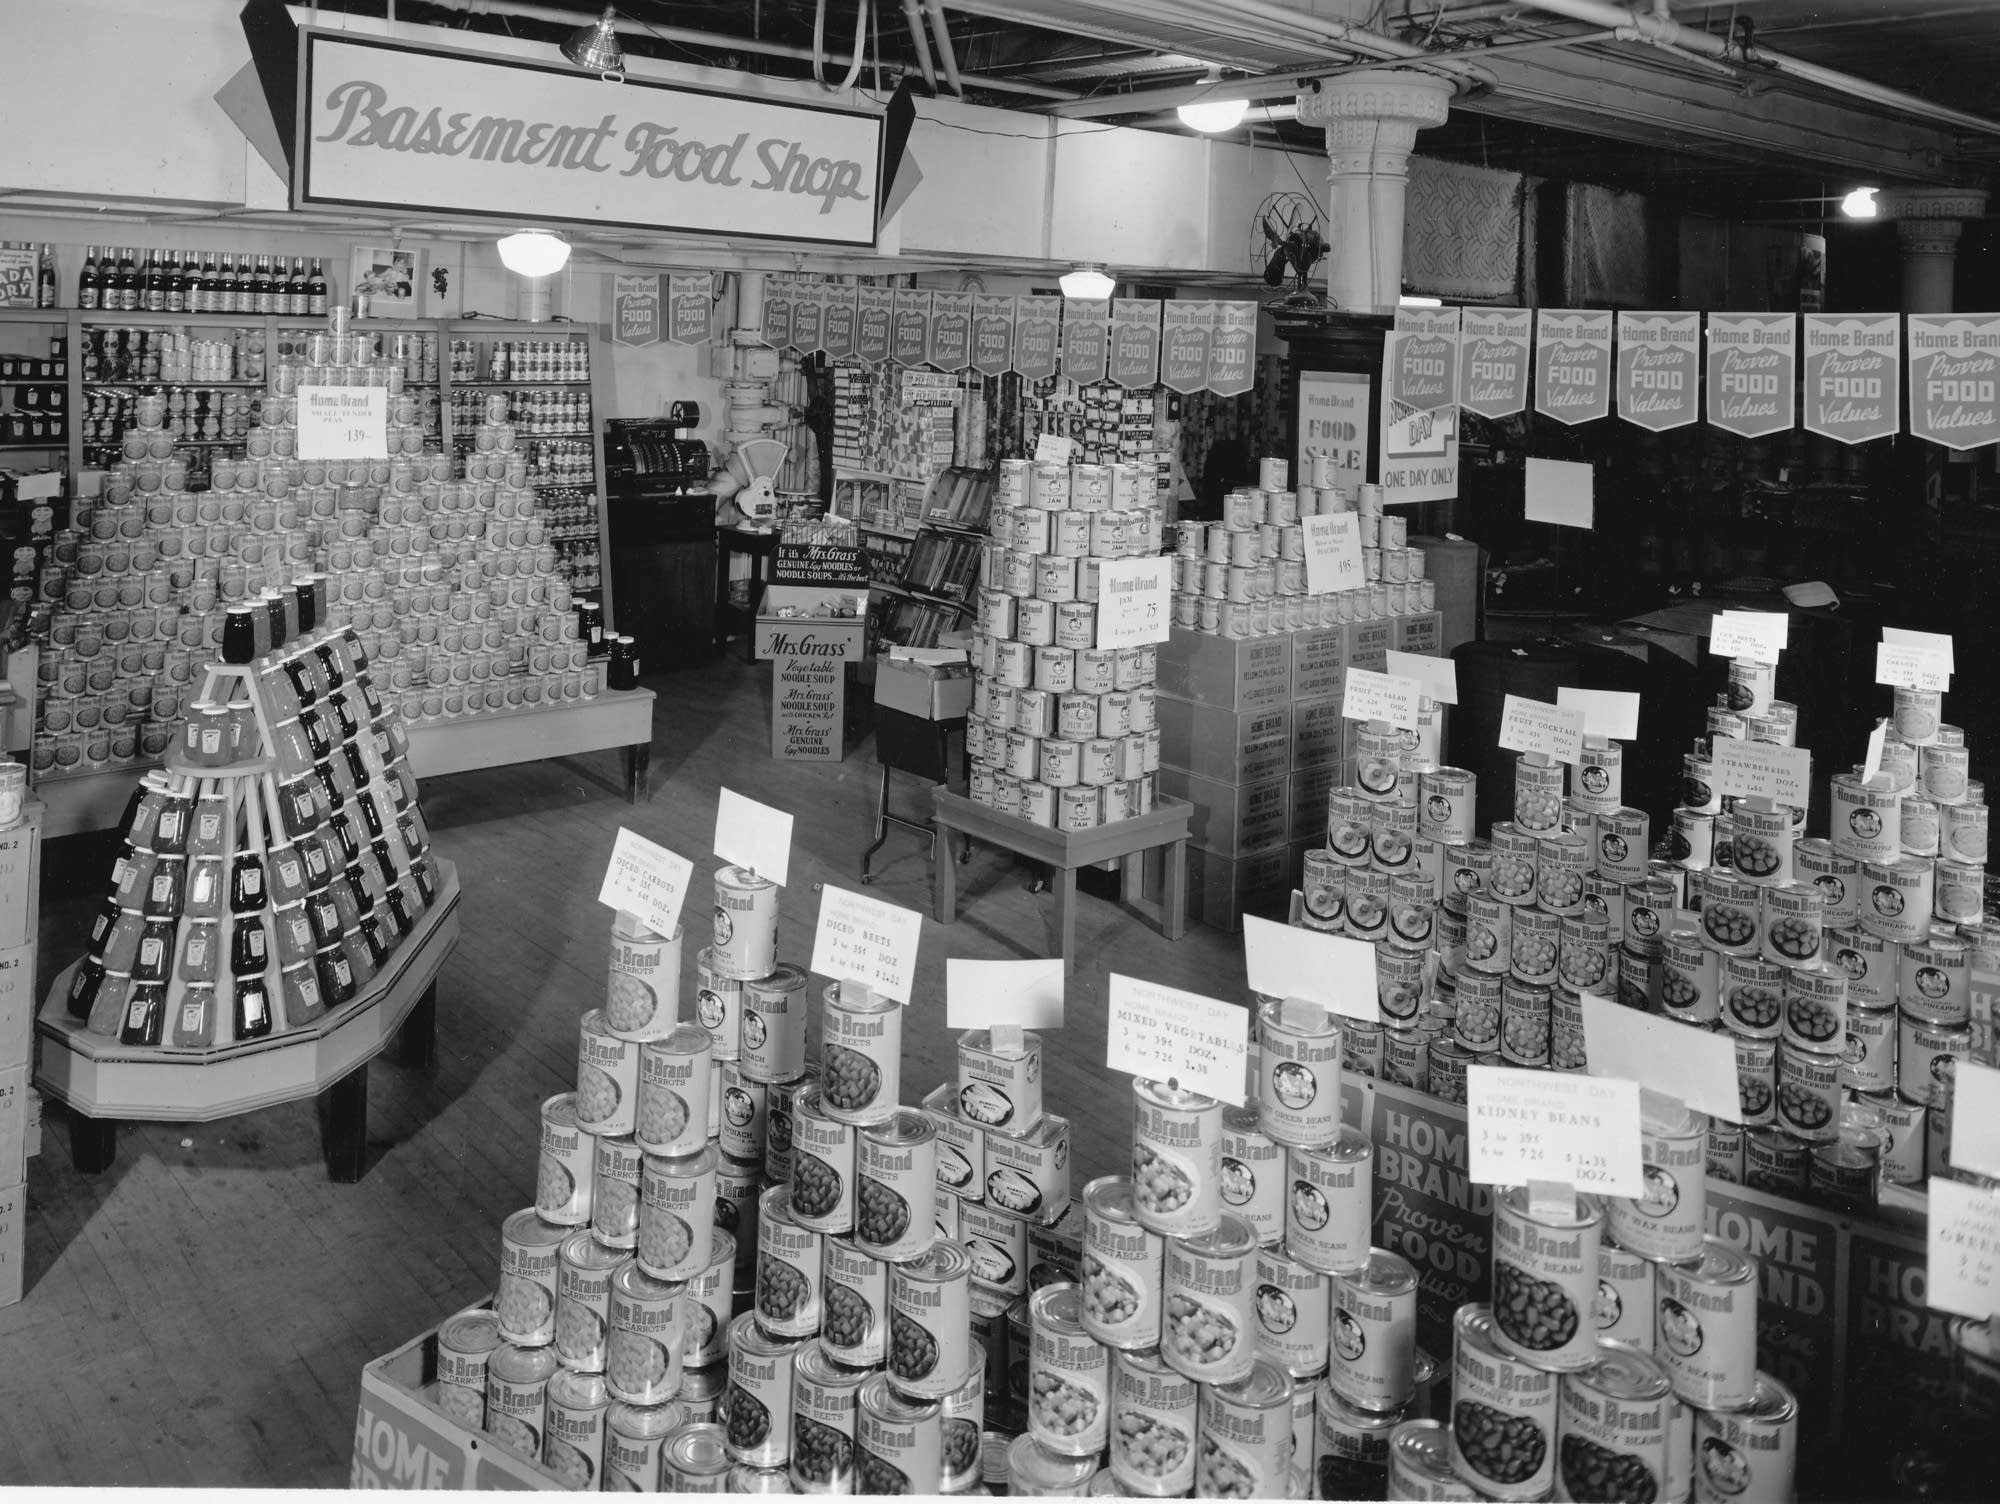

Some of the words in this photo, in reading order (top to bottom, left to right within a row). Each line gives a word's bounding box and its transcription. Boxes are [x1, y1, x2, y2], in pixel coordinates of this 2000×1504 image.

[316, 79, 617, 173] Basement
[619, 121, 750, 186] Food
[751, 138, 870, 215] Shop
[618, 283, 637, 292] Home
[638, 283, 657, 293] Brand
[623, 295, 651, 308] Proven
[622, 310, 651, 322] FOOD
[1167, 312, 1188, 324] Home
[1190, 313, 1211, 325] Brand
[1399, 319, 1426, 333] Home
[1427, 320, 1455, 333] Brand
[621, 323, 651, 337] Values
[1172, 328, 1204, 344] Proven
[1466, 320, 1495, 336] Home
[1497, 322, 1526, 337] Brand
[1541, 324, 1573, 339] Home
[1576, 325, 1608, 340] Brand
[1623, 326, 1656, 342] Home
[1660, 327, 1694, 342] Brand
[1712, 328, 1749, 344] Home
[1753, 329, 1790, 344] Brand
[1809, 329, 1849, 346] Home
[1853, 329, 1894, 346] Brand
[1404, 337, 1448, 356] Proven
[1914, 331, 1958, 348] Home
[1963, 331, 2000, 348] Bran
[1171, 346, 1202, 360] FOOD
[1472, 339, 1517, 361] Proven
[1549, 344, 1599, 365] Proven
[1631, 347, 1685, 369] Proven
[1403, 358, 1445, 376] FOOD
[1721, 349, 1780, 372] Proven
[1820, 352, 1883, 376] Proven
[1927, 354, 1996, 380] Proven
[1170, 364, 1200, 380] Values
[1471, 362, 1516, 381] FOOD
[1548, 366, 1597, 386] FOOD
[1631, 370, 1683, 390] FOOD
[1402, 378, 1445, 396] Values
[1470, 381, 1515, 401] Values
[1721, 373, 1778, 394] FOOD
[1820, 377, 1881, 398] FOOD
[1927, 380, 1995, 402] FOOD
[341, 393, 368, 407] Brand
[1308, 394, 1330, 408] Home
[1331, 395, 1354, 408] Brand
[1546, 388, 1596, 408] Values
[1629, 392, 1684, 414] Values
[1721, 395, 1778, 418] Values
[1819, 400, 1882, 424] Values
[1926, 404, 1997, 431] Values
[1309, 419, 1356, 442] FOOD
[1408, 411, 1435, 447] DAY
[1304, 446, 1361, 470] SLE
[1385, 471, 1405, 488] ONE
[1410, 469, 1429, 486] DAY
[1432, 467, 1455, 484] ONLY
[776, 570, 806, 579] NOODLE
[777, 560, 809, 569] GENUINE
[822, 562, 854, 571] NOODLES
[1110, 578, 1133, 592] Home
[1135, 575, 1157, 591] Brand
[763, 632, 798, 656] Mrs.
[785, 659, 835, 674] Vegetable
[781, 673, 810, 683] NOODLE
[811, 674, 835, 684] SOUP
[781, 701, 810, 711] NOODLE
[811, 702, 835, 711] SOUP
[1509, 716, 1533, 726] FRUIT
[1538, 722, 1577, 736] COCKTAIL
[790, 736, 823, 745] GENUINE
[797, 746, 830, 755] NOODLES
[1720, 759, 1791, 775] STRAWBERRIES
[616, 857, 639, 873] DICED
[643, 871, 674, 893] CARROTS
[826, 920, 855, 934] DICED
[863, 930, 891, 947] BEETS
[623, 946, 661, 966] Brand
[618, 965, 654, 975] CARROTS
[842, 1015, 883, 1037] Brand
[1117, 1009, 1157, 1027] MIXED
[842, 1032, 871, 1047] BEETS
[1297, 1040, 1337, 1062] Brand
[960, 1052, 985, 1070] Home
[987, 1059, 1014, 1079] Brand
[649, 1074, 686, 1086] CARROTS
[1477, 1105, 1540, 1121] KIDNEY
[1549, 1111, 1601, 1128] BEANS
[1385, 1109, 1468, 1170] HOM
[1379, 1145, 1494, 1216] BRAND
[1373, 1186, 1487, 1252] Proven
[1383, 1220, 1480, 1281] FOOD
